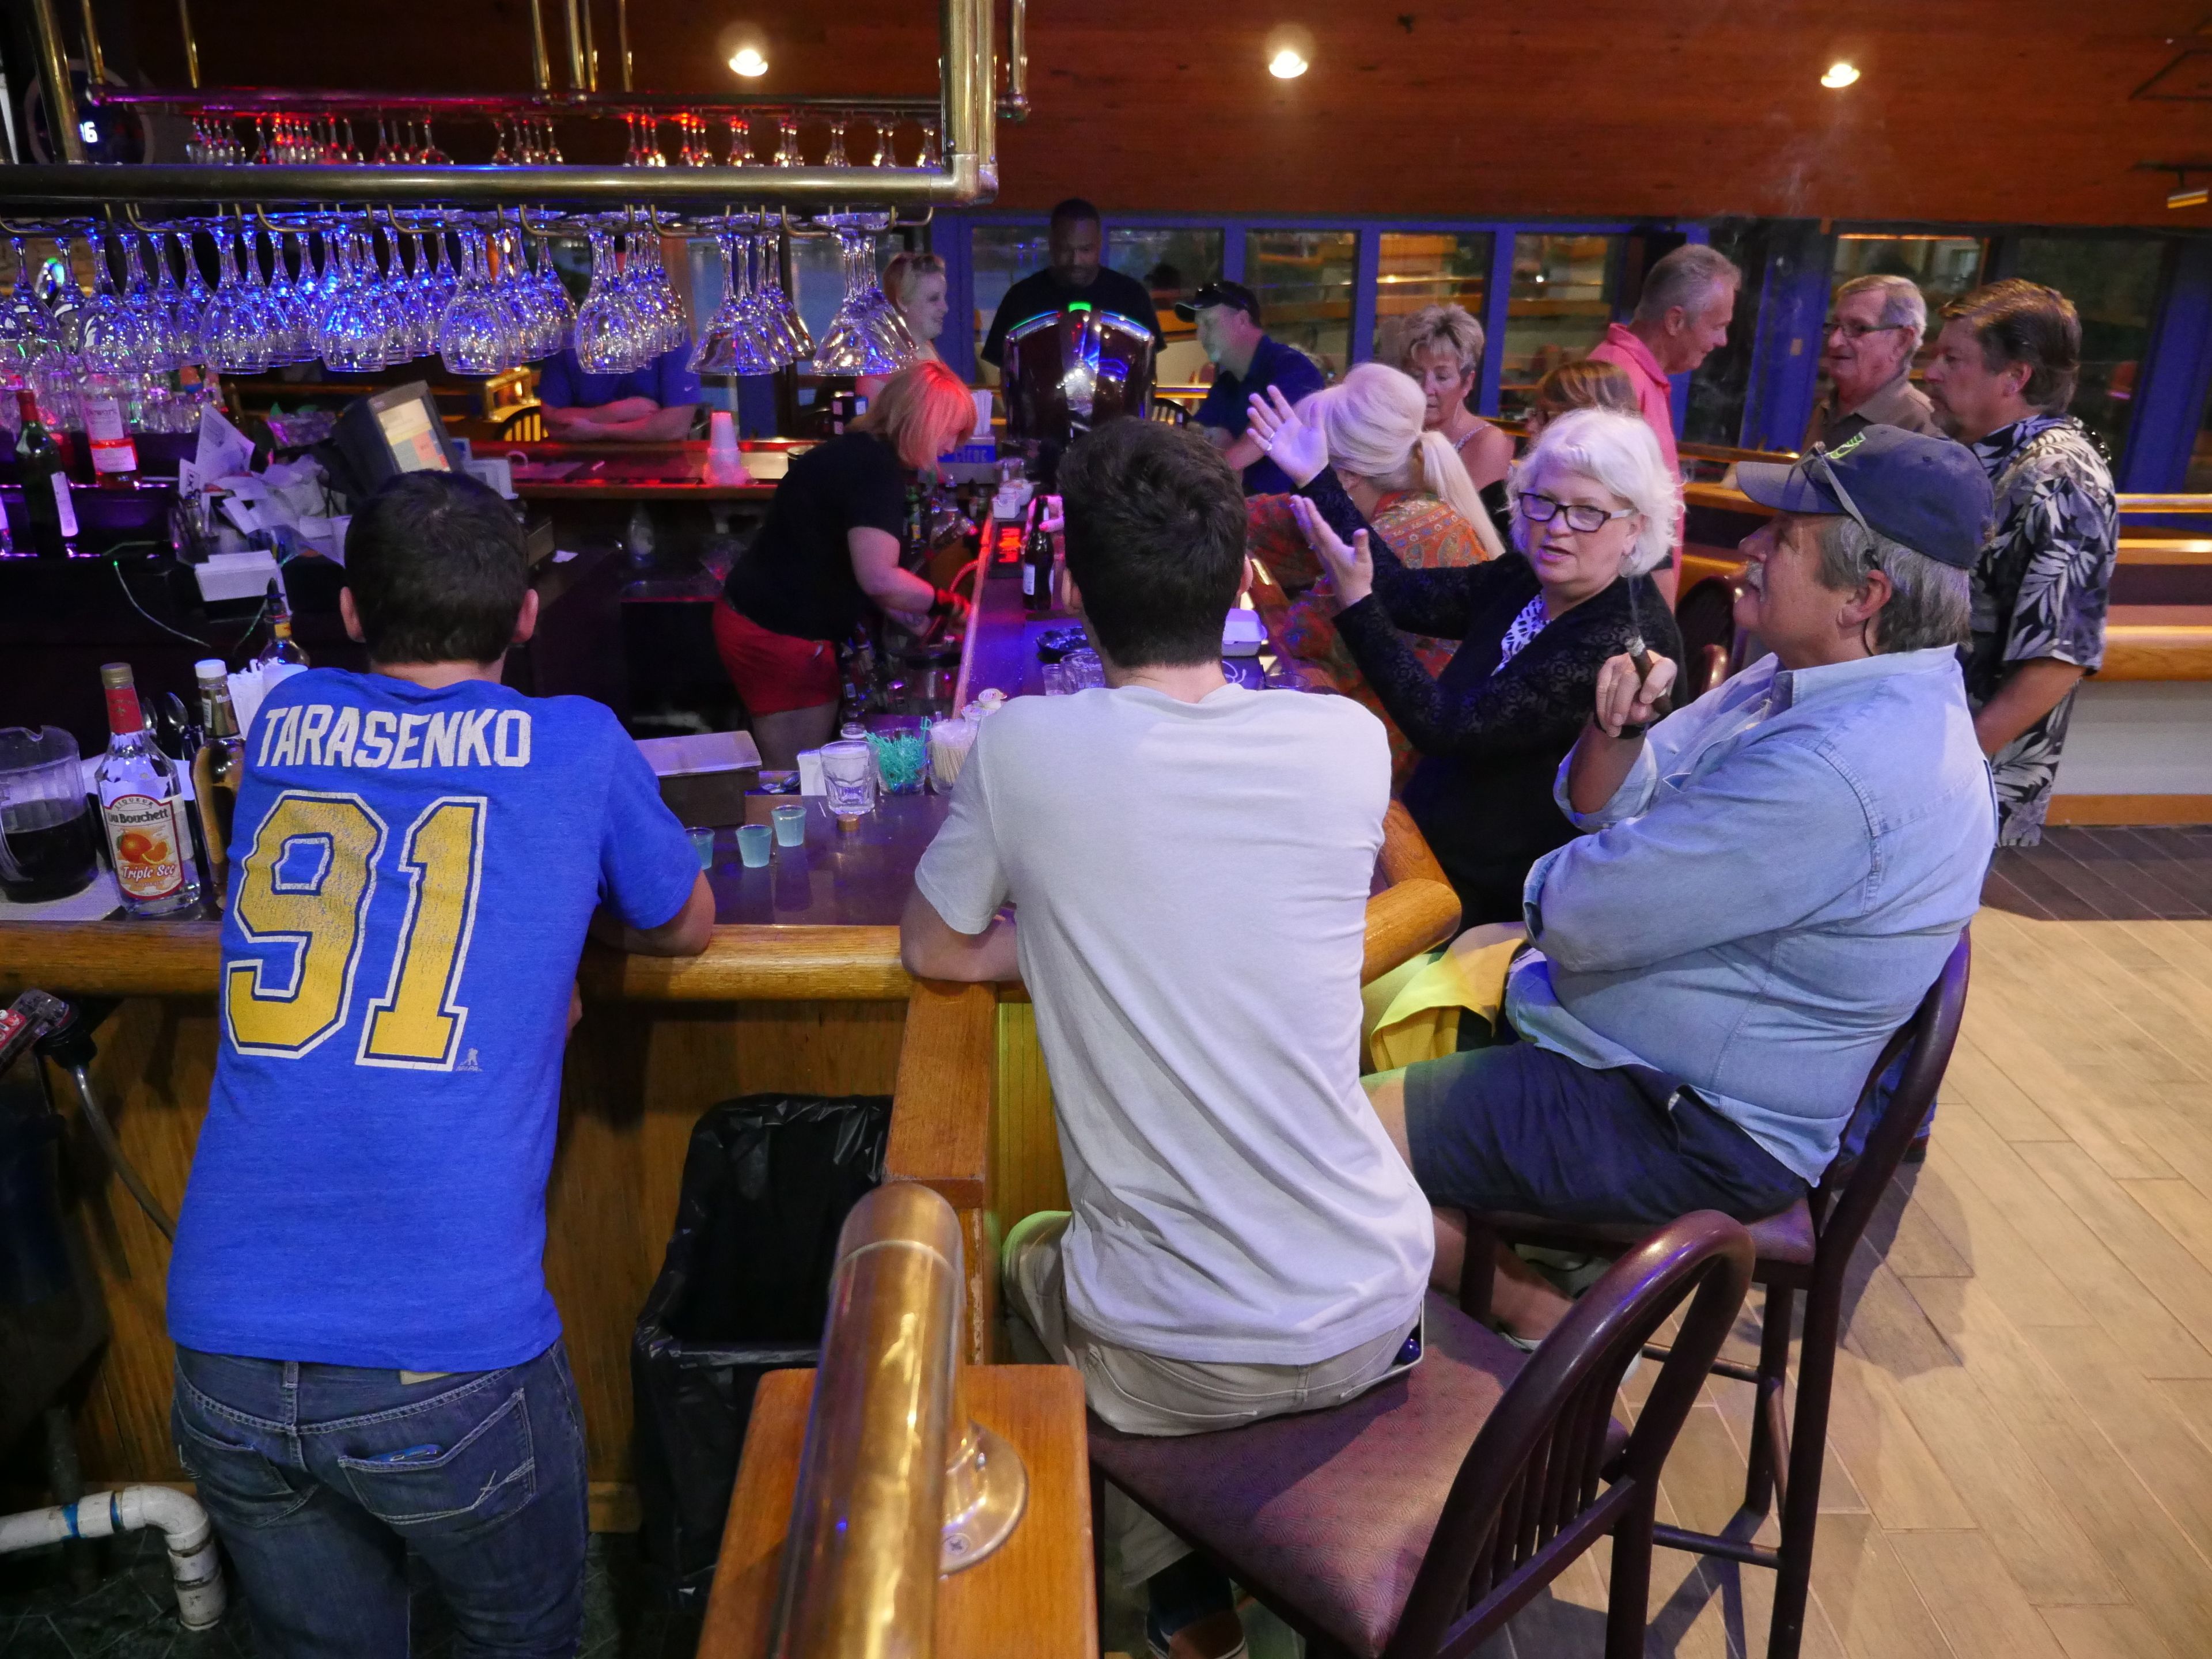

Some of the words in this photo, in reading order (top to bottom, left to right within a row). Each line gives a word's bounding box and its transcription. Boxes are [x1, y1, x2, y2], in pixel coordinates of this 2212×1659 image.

[257, 704, 531, 769] TARASENKO
[114, 797, 153, 809] LIQUEUR
[123, 866, 154, 880] Triple
[156, 864, 175, 876] Sec
[226, 790, 487, 1071] 91
